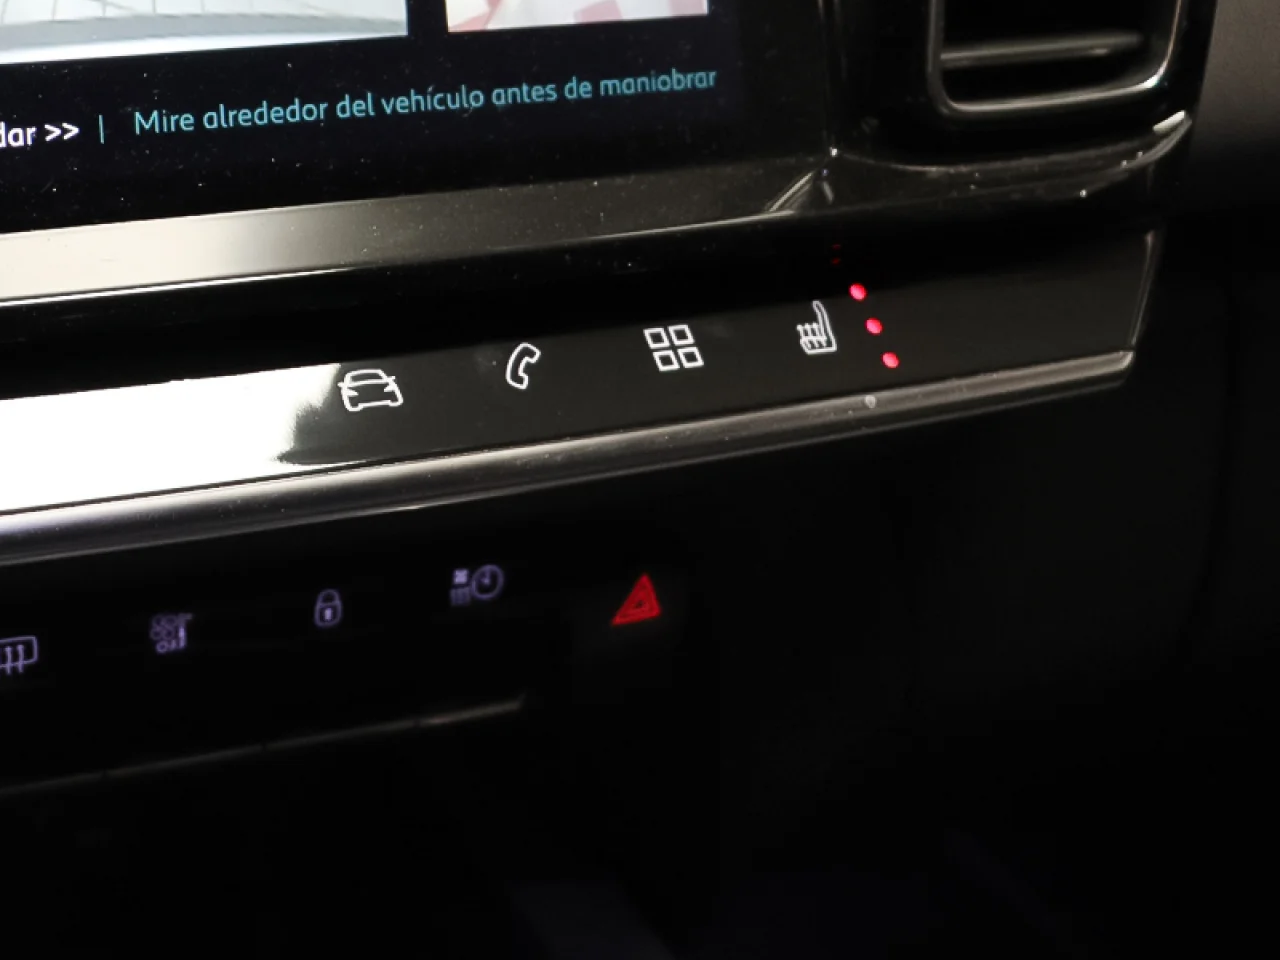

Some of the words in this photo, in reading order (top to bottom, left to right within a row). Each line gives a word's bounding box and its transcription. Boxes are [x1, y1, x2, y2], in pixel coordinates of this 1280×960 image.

[135, 110, 194, 135] Mire
[203, 98, 328, 128] alrededor
[336, 90, 375, 118] del
[382, 84, 484, 114] vehículo
[492, 83, 557, 105] antes
[565, 77, 592, 99] de
[600, 69, 717, 96] maniobrar
